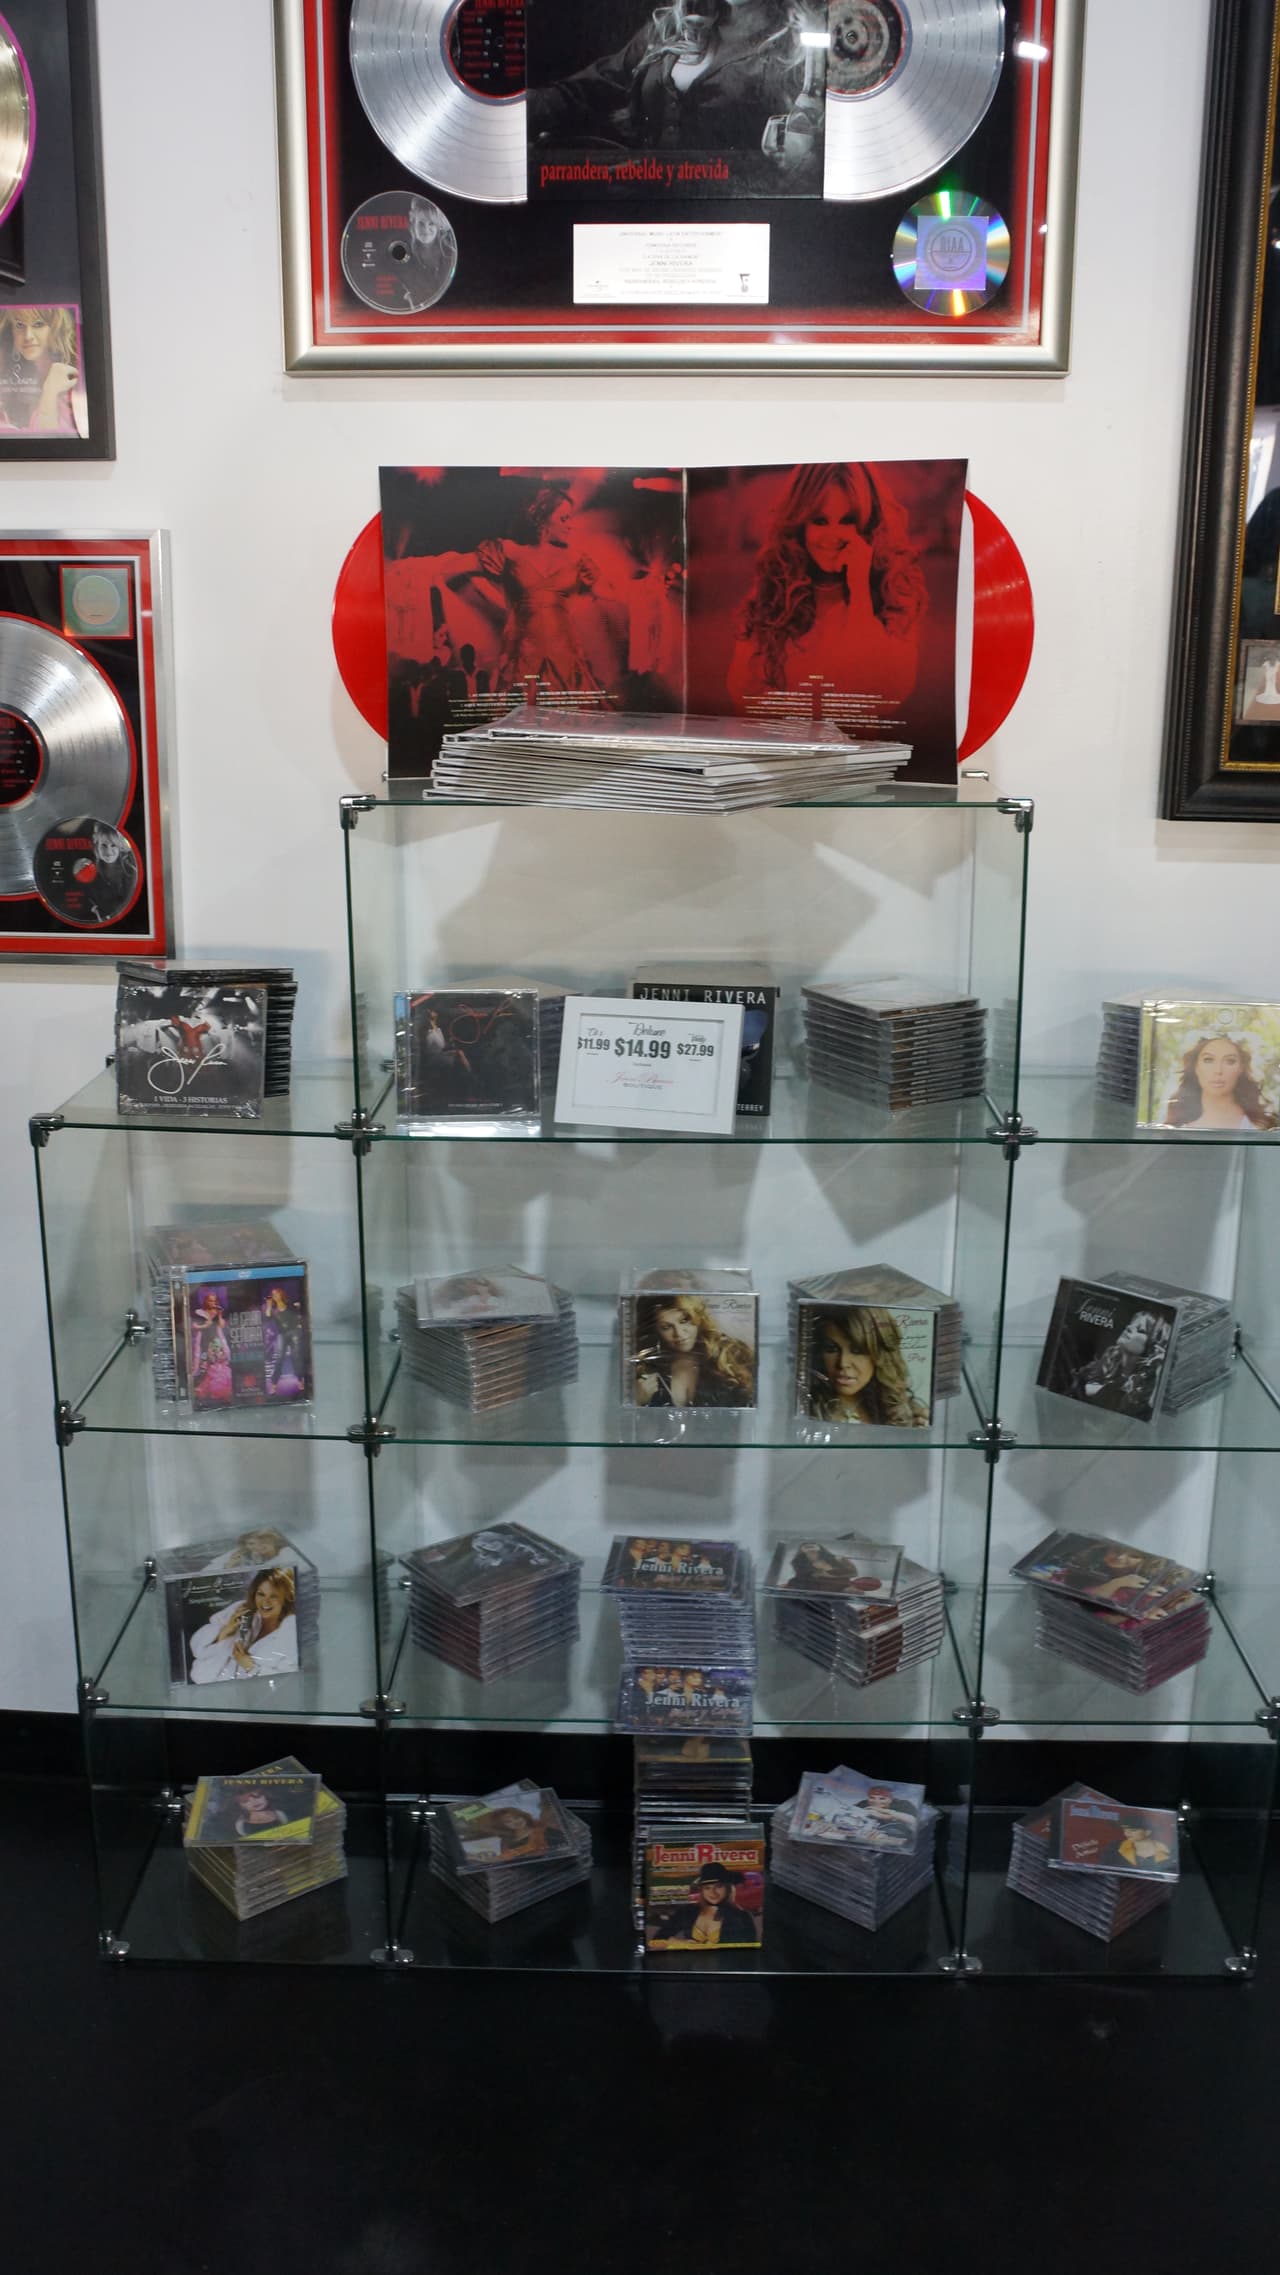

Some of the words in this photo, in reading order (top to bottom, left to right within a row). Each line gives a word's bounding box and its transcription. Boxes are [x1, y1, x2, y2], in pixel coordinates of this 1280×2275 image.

[541, 160, 613, 188] parrandera,
[616, 158, 663, 180] rebelde
[667, 164, 675, 187] y
[677, 157, 729, 180] atrevida
[640, 987, 690, 1001] JENNI
[704, 990, 767, 1005] RIVERA
[577, 1036, 611, 1051] $11.99
[614, 1037, 671, 1060] $14.99
[676, 1042, 714, 1057] $27.99
[736, 1103, 764, 1112] TERREY
[1079, 1311, 1115, 1329] RIVERA
[632, 1560, 673, 1574] Jenni
[677, 1562, 724, 1576] Rivera
[645, 1692, 686, 1706] Jenni
[691, 1693, 740, 1708] Rivera
[654, 1845, 696, 1866] Jenni
[695, 1843, 759, 1864] Rivera
